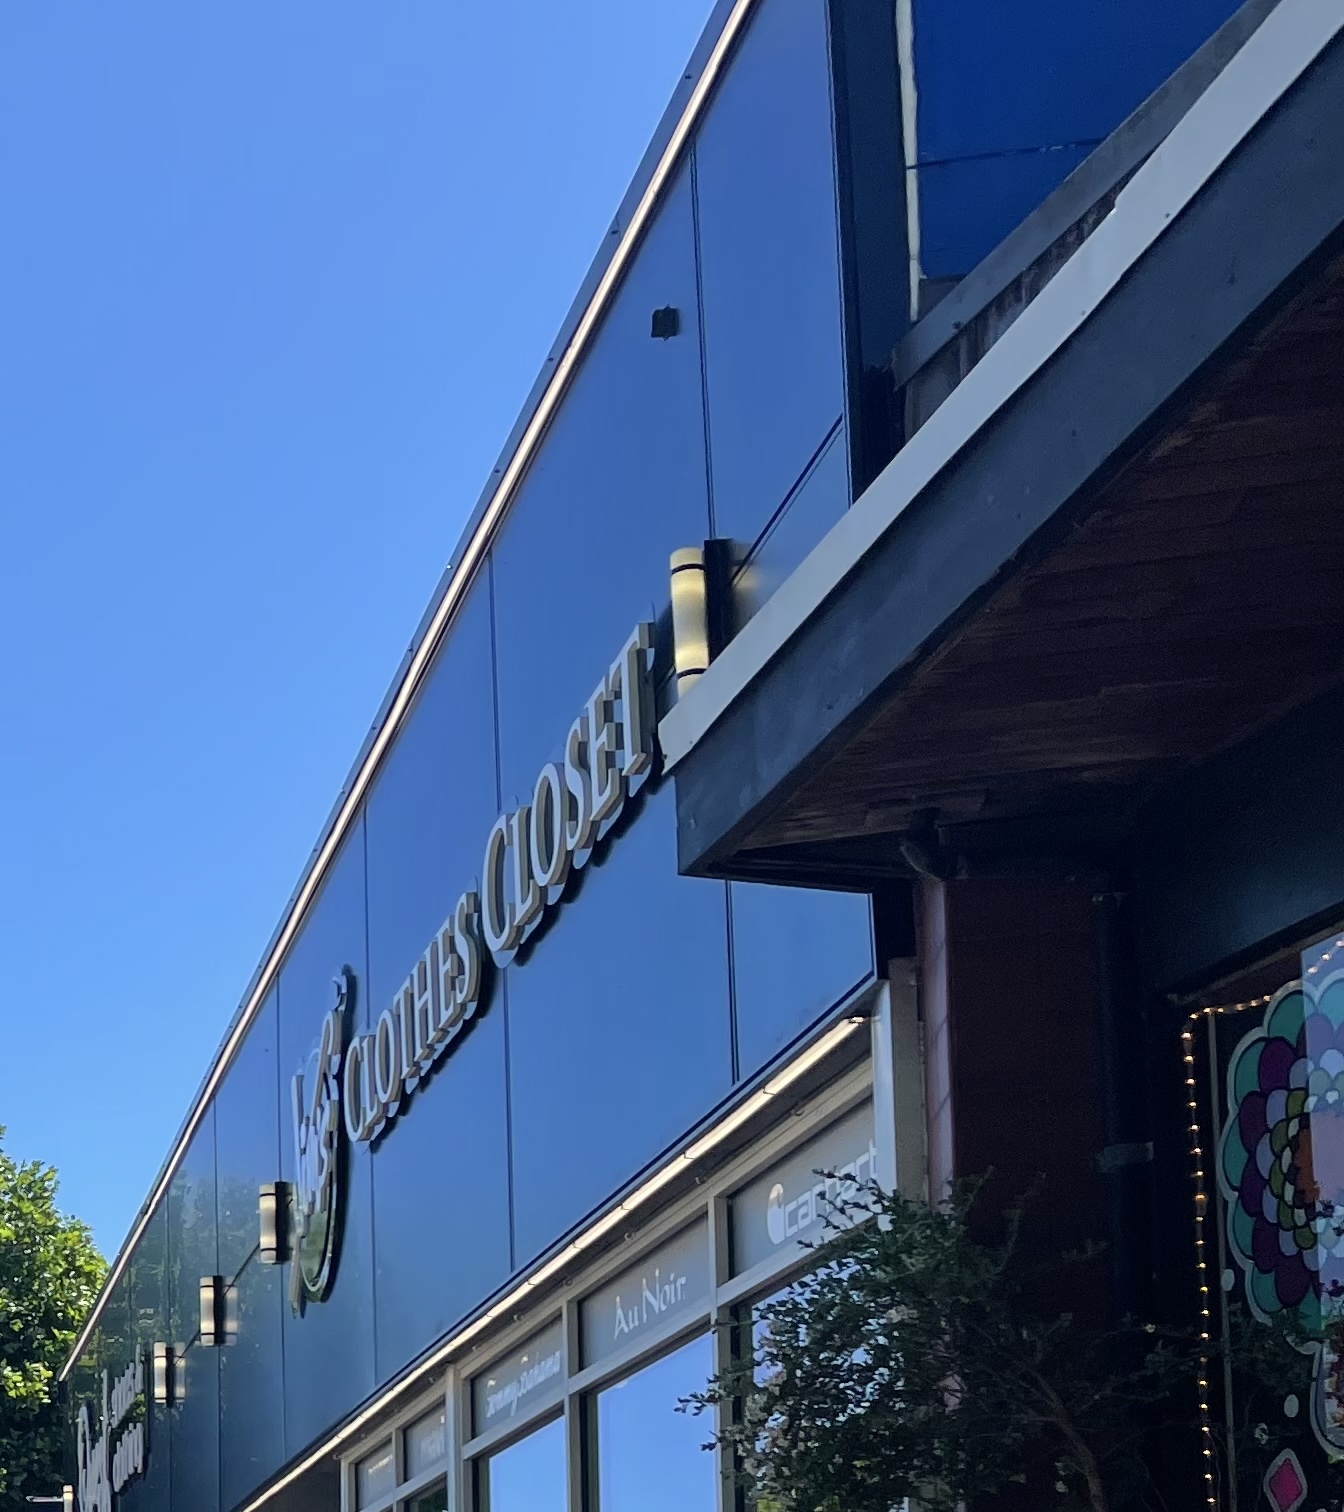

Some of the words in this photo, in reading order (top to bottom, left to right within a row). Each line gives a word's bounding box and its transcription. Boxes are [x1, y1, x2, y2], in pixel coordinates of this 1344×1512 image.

[343, 891, 479, 1143] CLOTHES
[481, 622, 655, 952] CLOSET
[614, 1295, 639, 1341] Au
[642, 1267, 687, 1323] Noir
